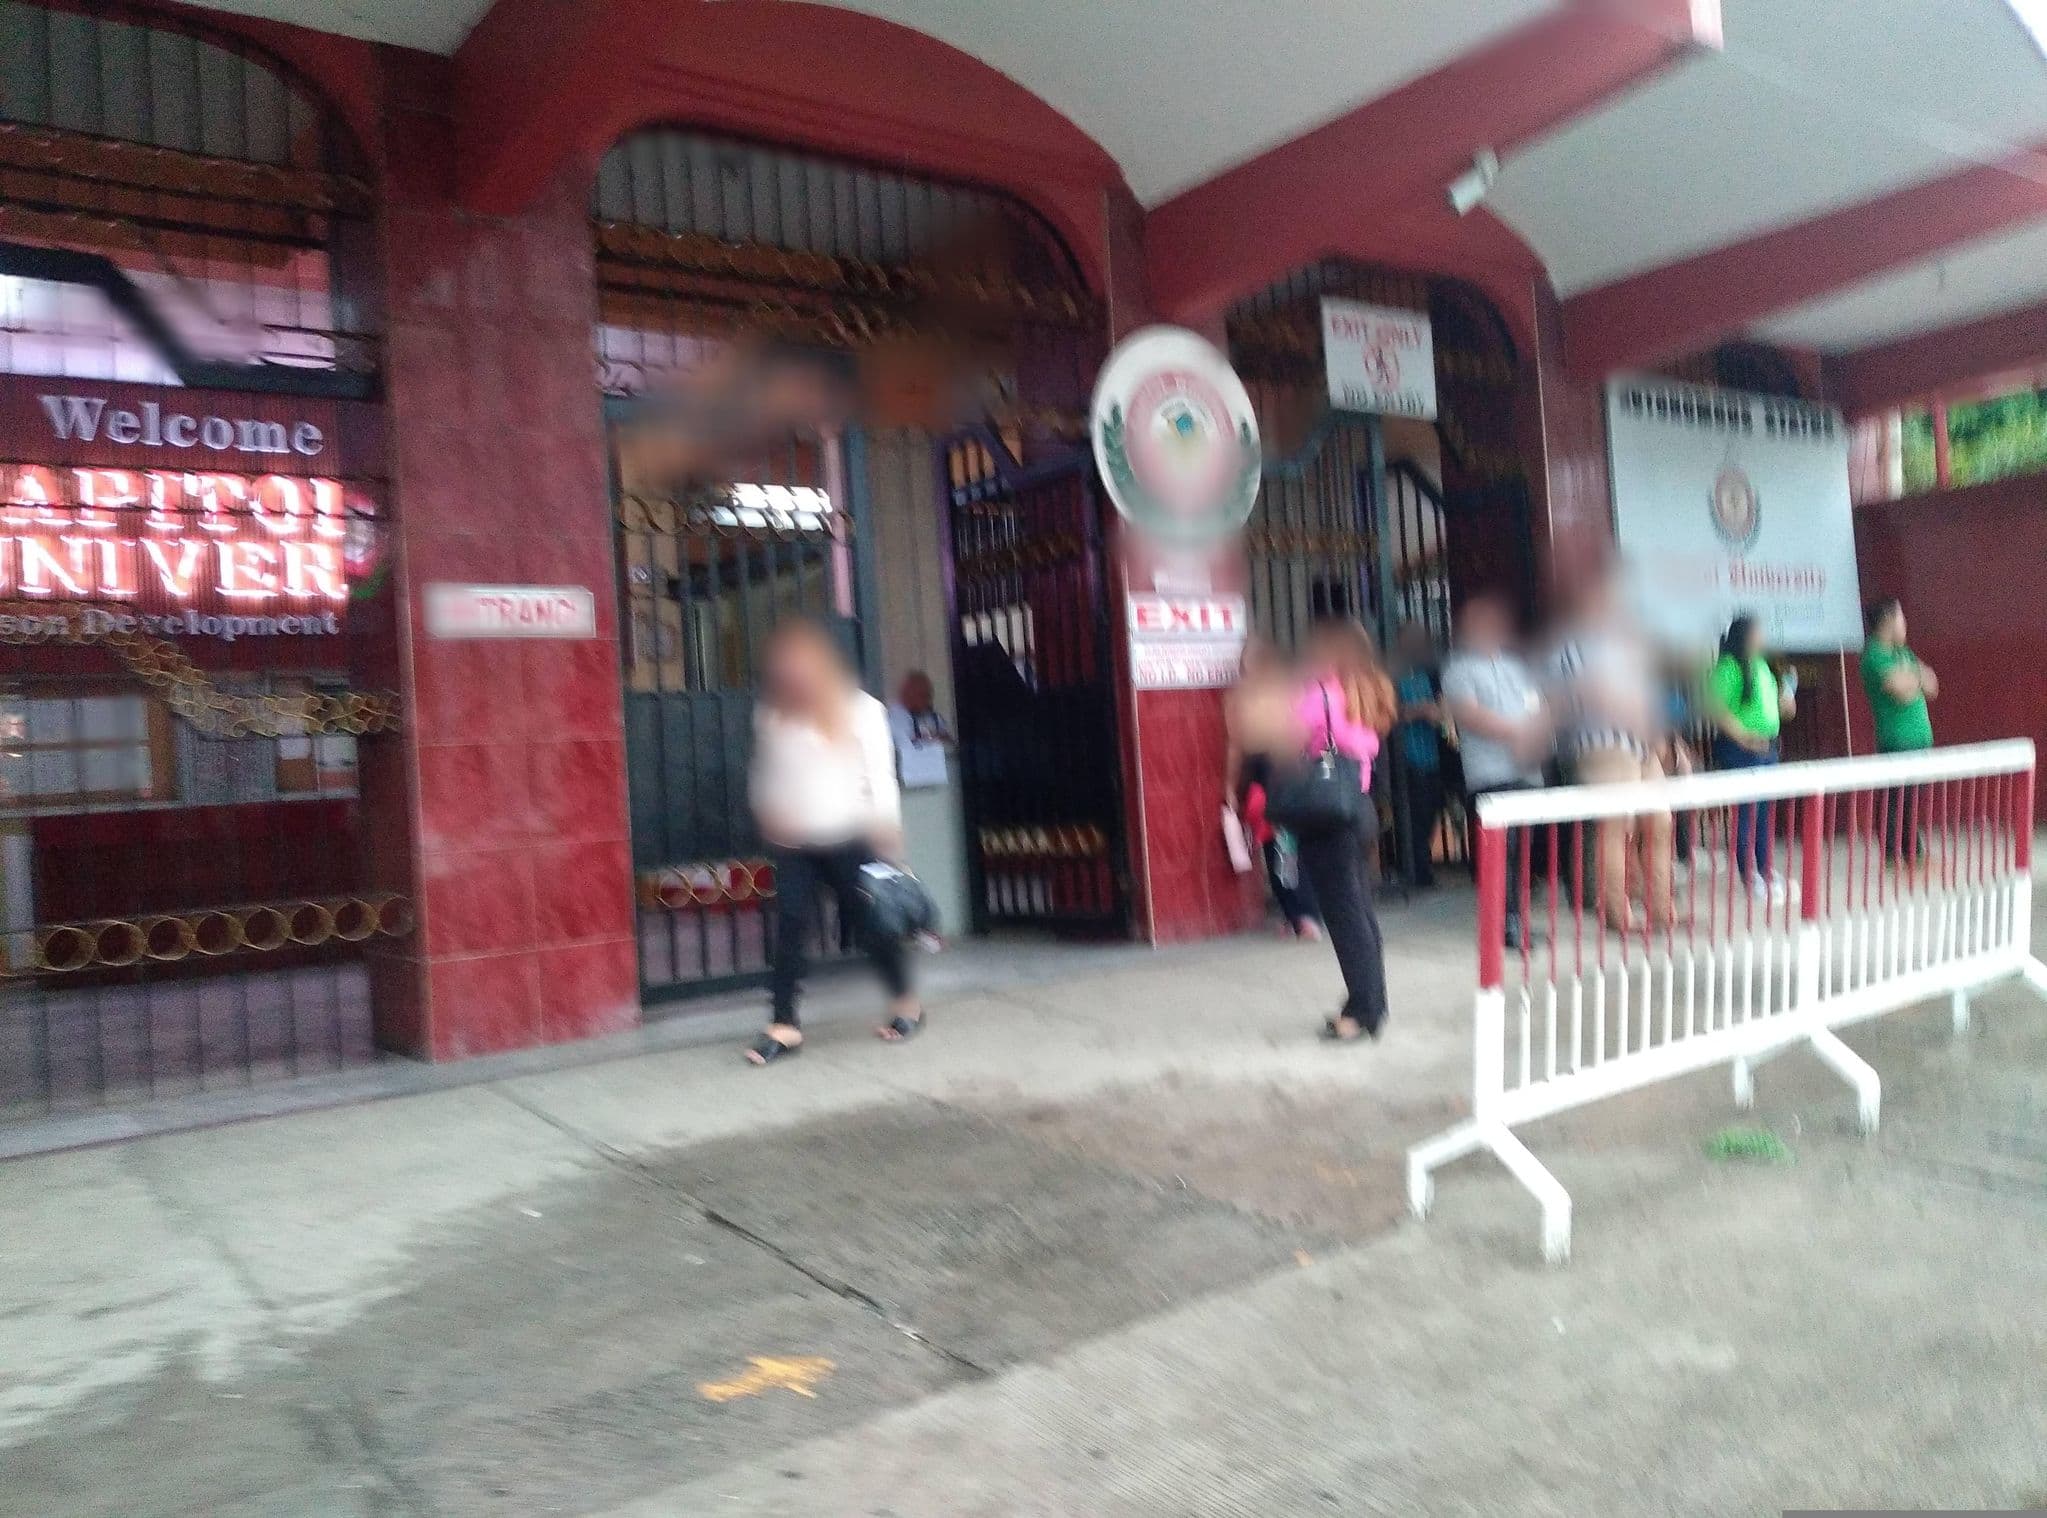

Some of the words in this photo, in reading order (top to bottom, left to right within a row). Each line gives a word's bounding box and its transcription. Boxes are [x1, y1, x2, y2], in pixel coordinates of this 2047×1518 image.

[38, 395, 325, 456] Welcome
[0, 465, 345, 537] APITOL
[1135, 601, 1236, 633] EXIT
